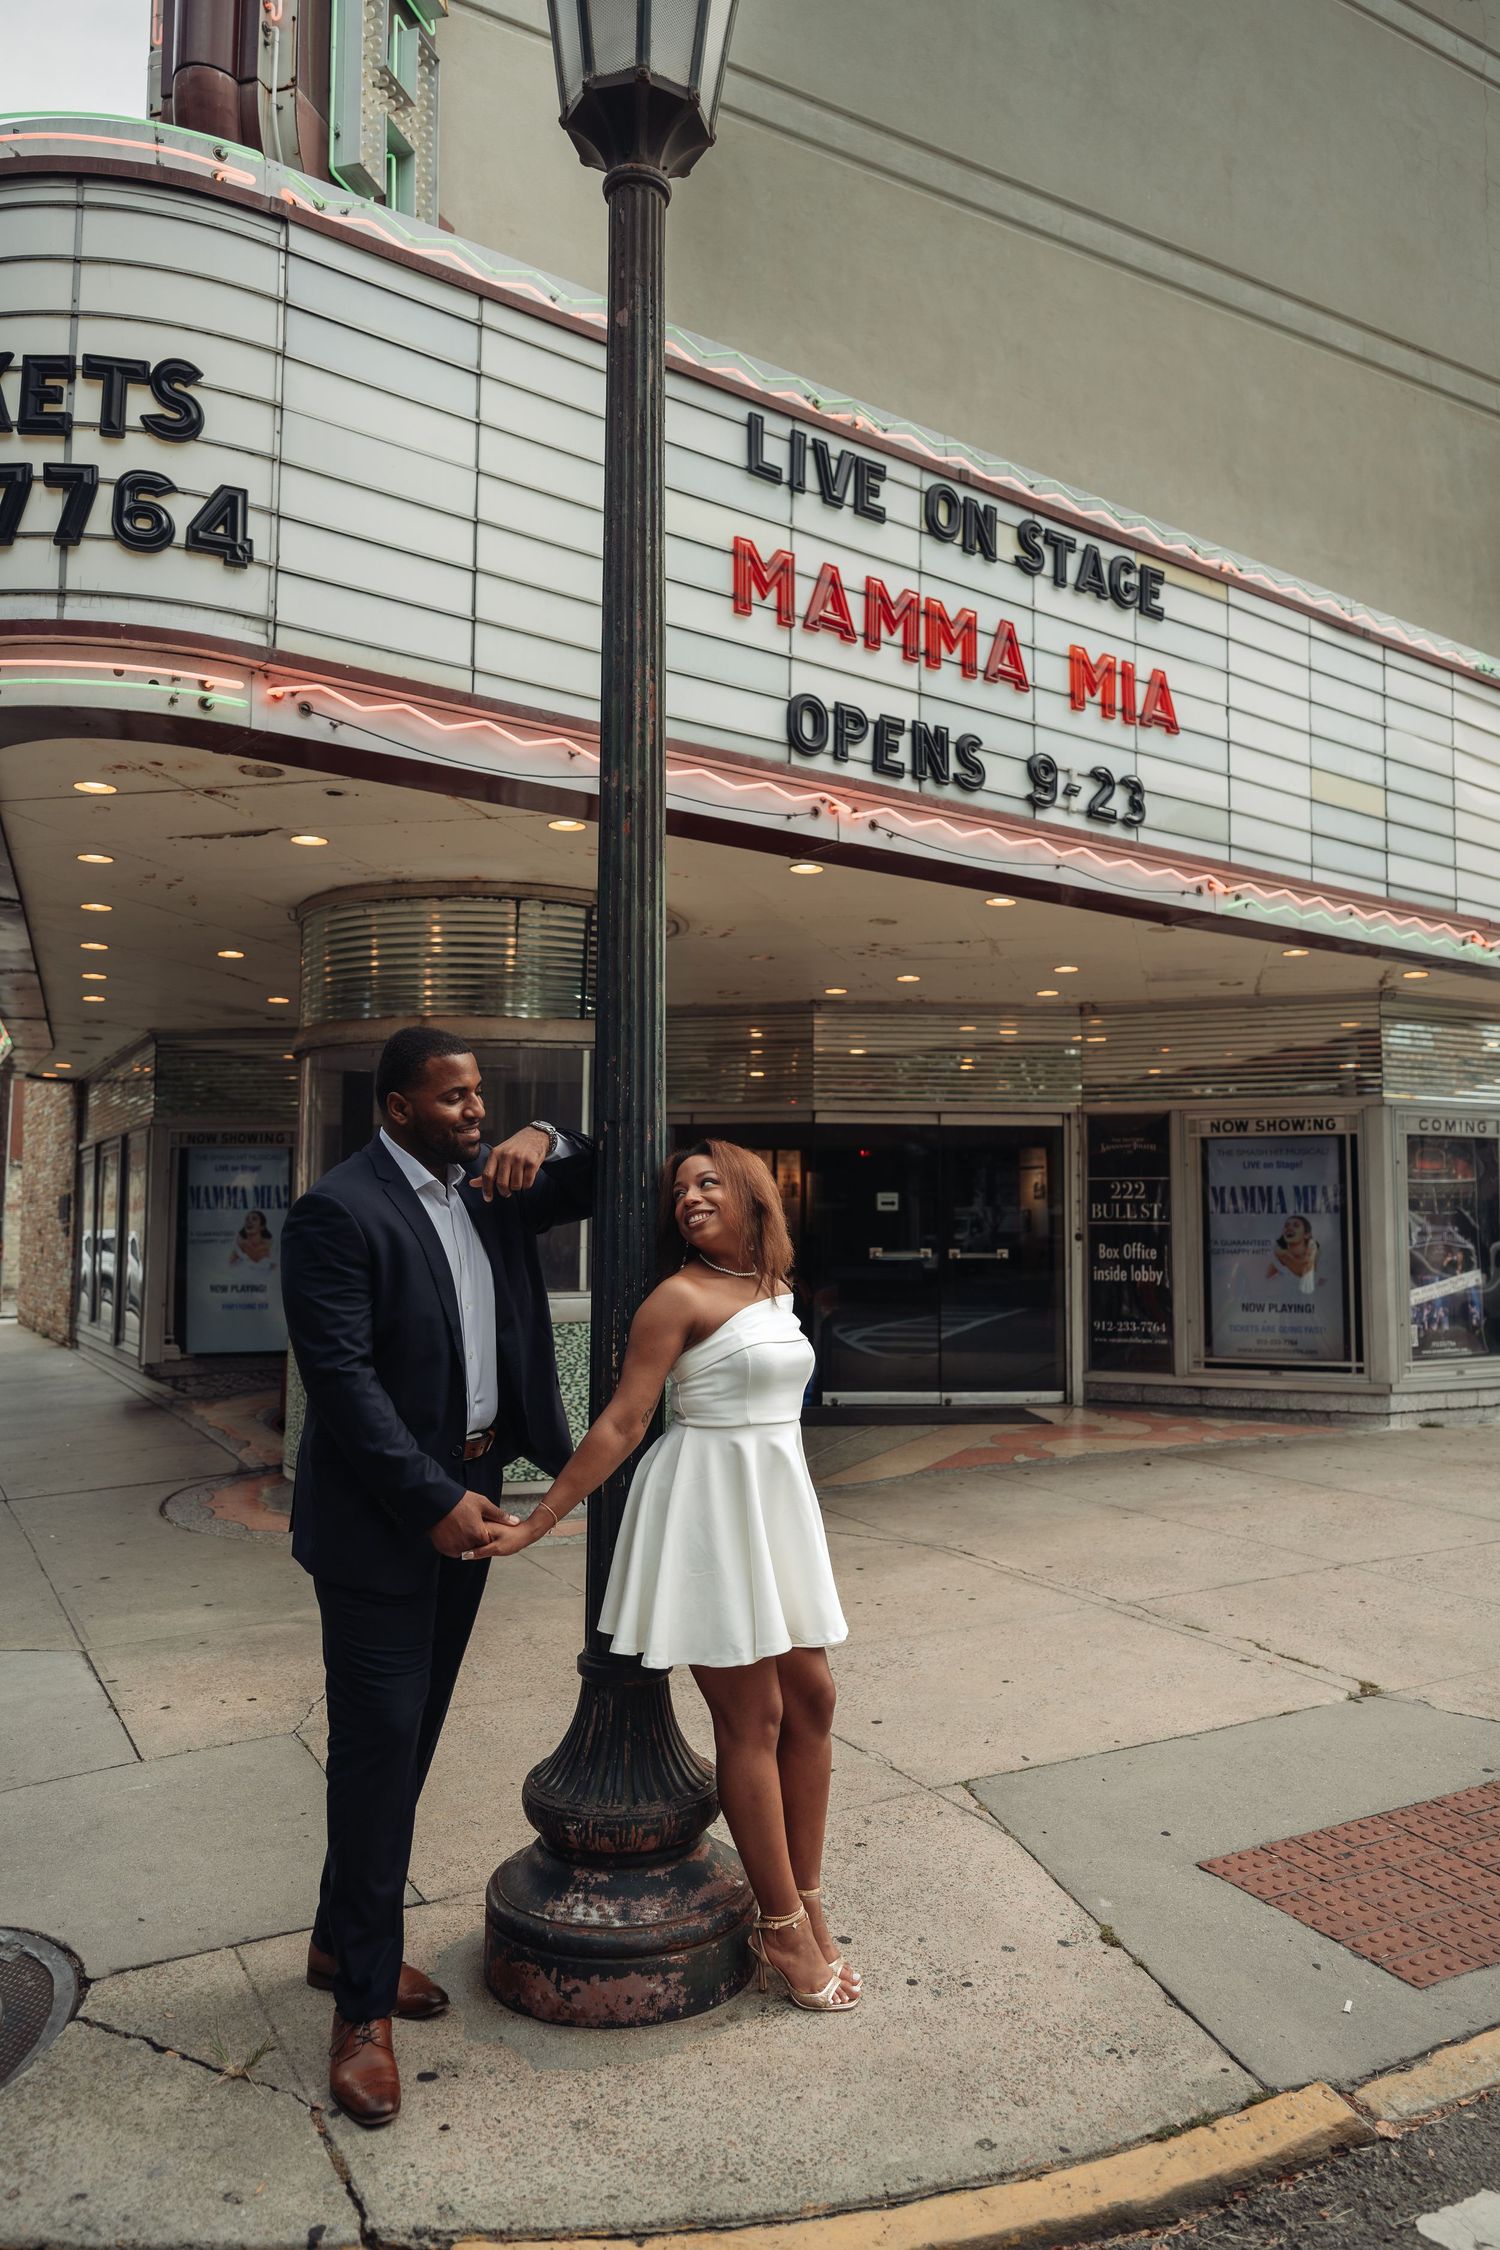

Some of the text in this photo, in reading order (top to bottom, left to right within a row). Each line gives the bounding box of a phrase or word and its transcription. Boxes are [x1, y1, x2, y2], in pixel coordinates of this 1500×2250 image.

[747, 411, 1166, 622] LIVE ON STAGE
[732, 535, 1181, 735] MAMMA MIA
[786, 692, 1147, 828] OPENS 9-23
[1210, 1117, 1337, 1133] NOW SHOWING
[1418, 1118, 1487, 1134] COMING
[187, 1132, 285, 1145] NOW SHOWING
[1243, 1160, 1261, 1169] LIVE
[1276, 1160, 1303, 1171] Stage!
[188, 1184, 289, 1210] MAMMA MIA!
[1110, 1181, 1146, 1199] 222
[1209, 1184, 1340, 1214] MAMMA MIA!
[1092, 1202, 1166, 1219] BULL ST.
[1098, 1242, 1157, 1260] Box Office
[1093, 1264, 1163, 1287] inside lobby
[1241, 1302, 1315, 1314] NOW PLAYING!
[1093, 1320, 1167, 1333] 912-233-7764
